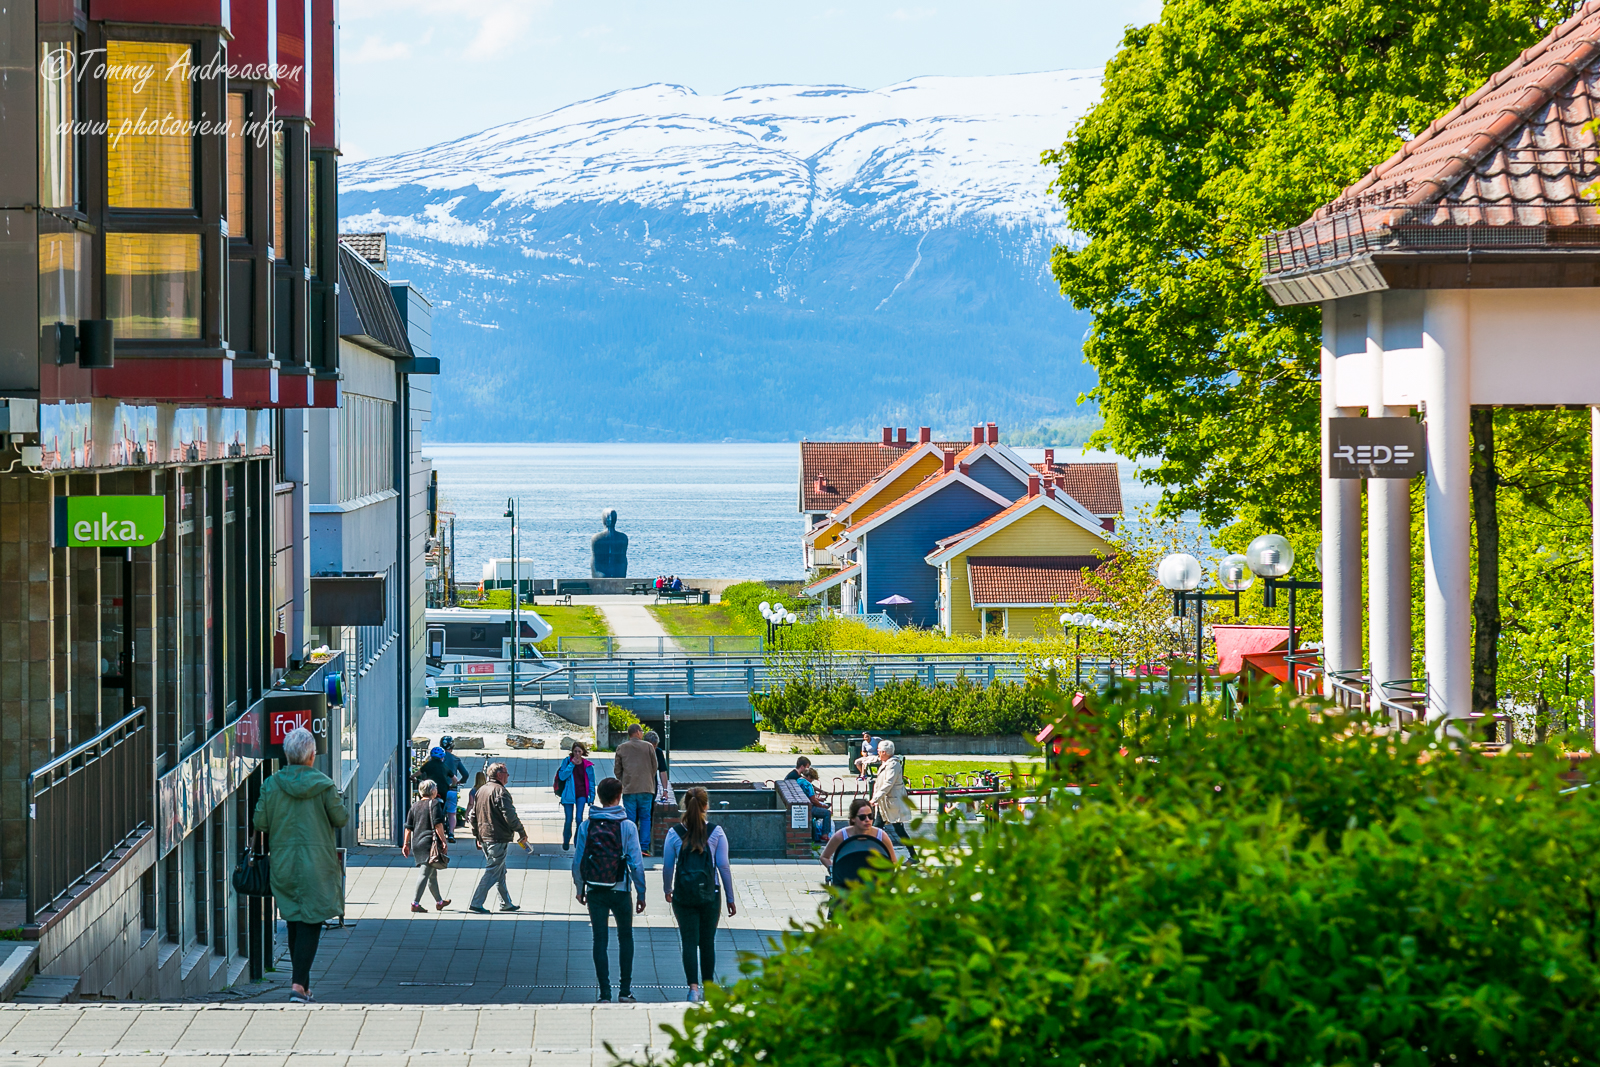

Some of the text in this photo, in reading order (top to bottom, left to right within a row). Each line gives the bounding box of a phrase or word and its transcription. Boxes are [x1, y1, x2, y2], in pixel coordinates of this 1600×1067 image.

[1333, 445, 1415, 465] REDE
[73, 511, 145, 542] eika.
[273, 713, 309, 737] folk
[312, 717, 327, 738] og
